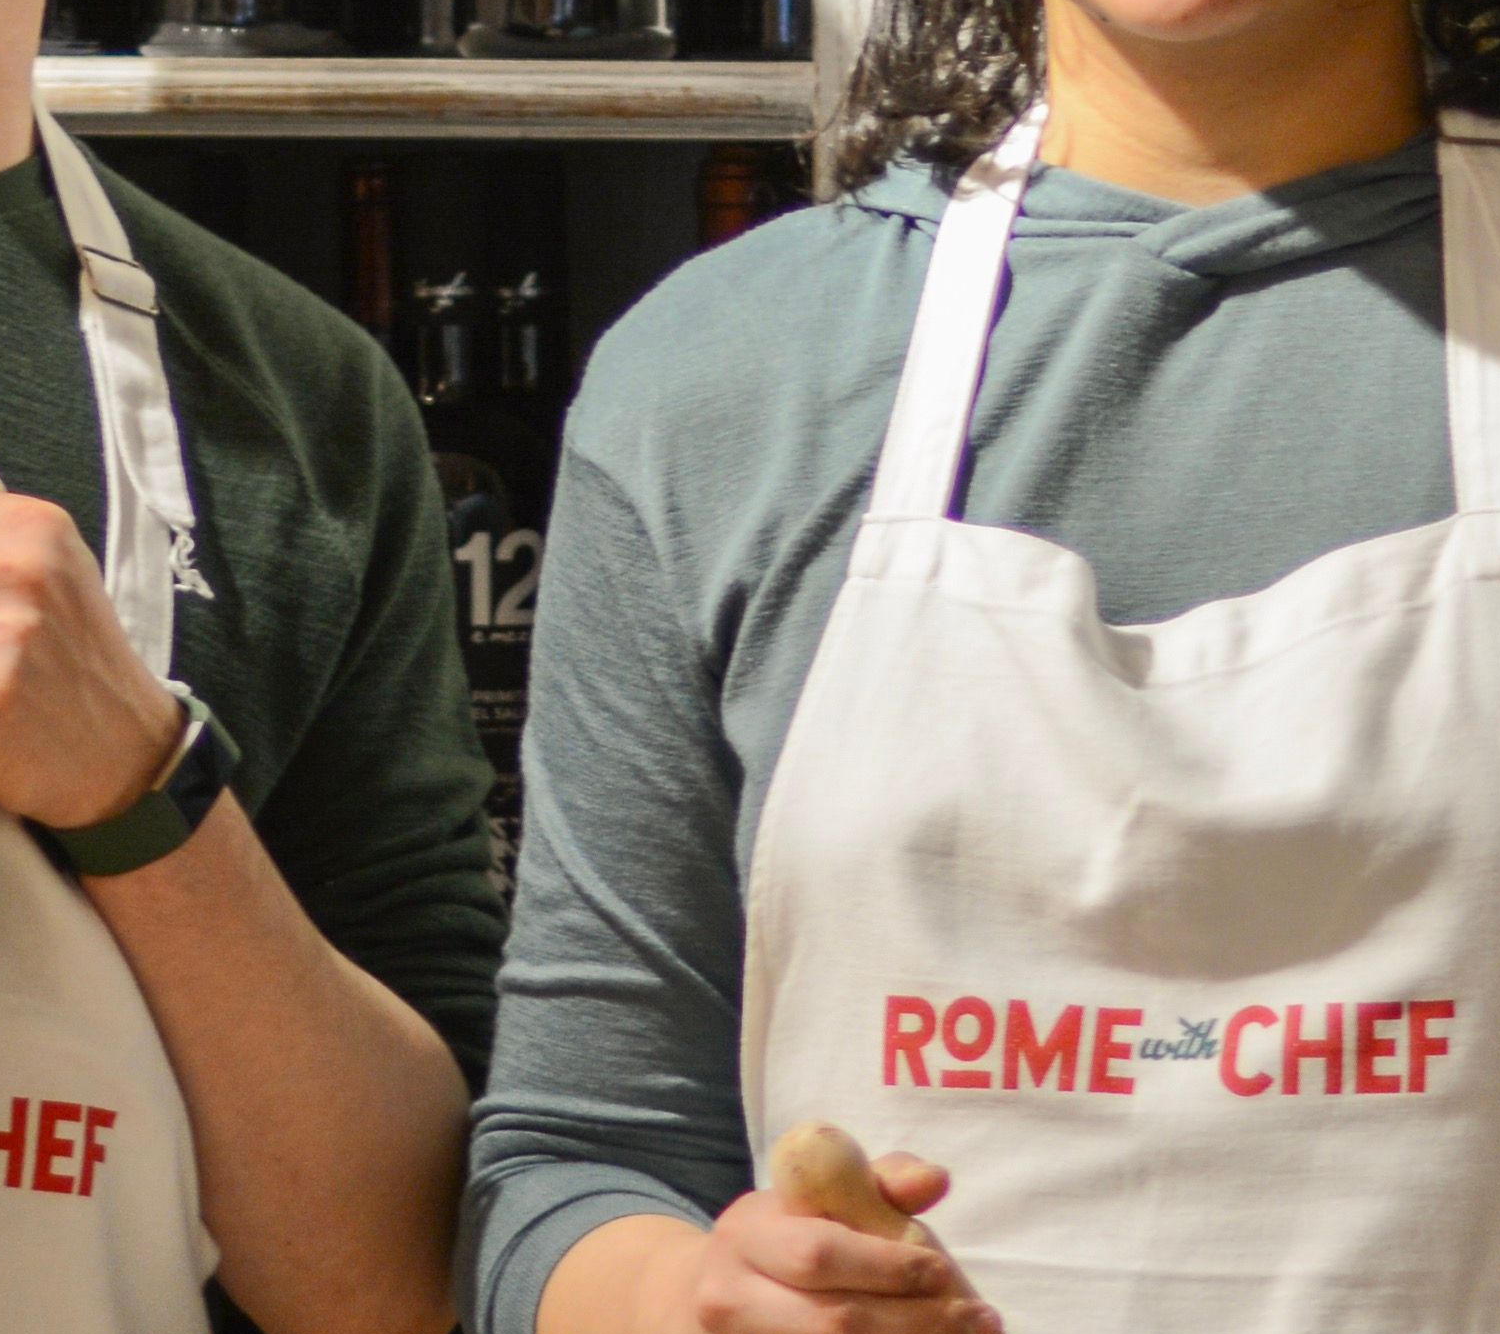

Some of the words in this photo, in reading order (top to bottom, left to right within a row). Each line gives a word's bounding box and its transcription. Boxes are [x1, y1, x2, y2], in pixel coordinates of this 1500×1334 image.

[455, 528, 543, 627] 12
[883, 995, 1144, 1095] ROME
[1140, 1017, 1218, 1062] with
[1219, 1004, 1455, 1097] CHEF
